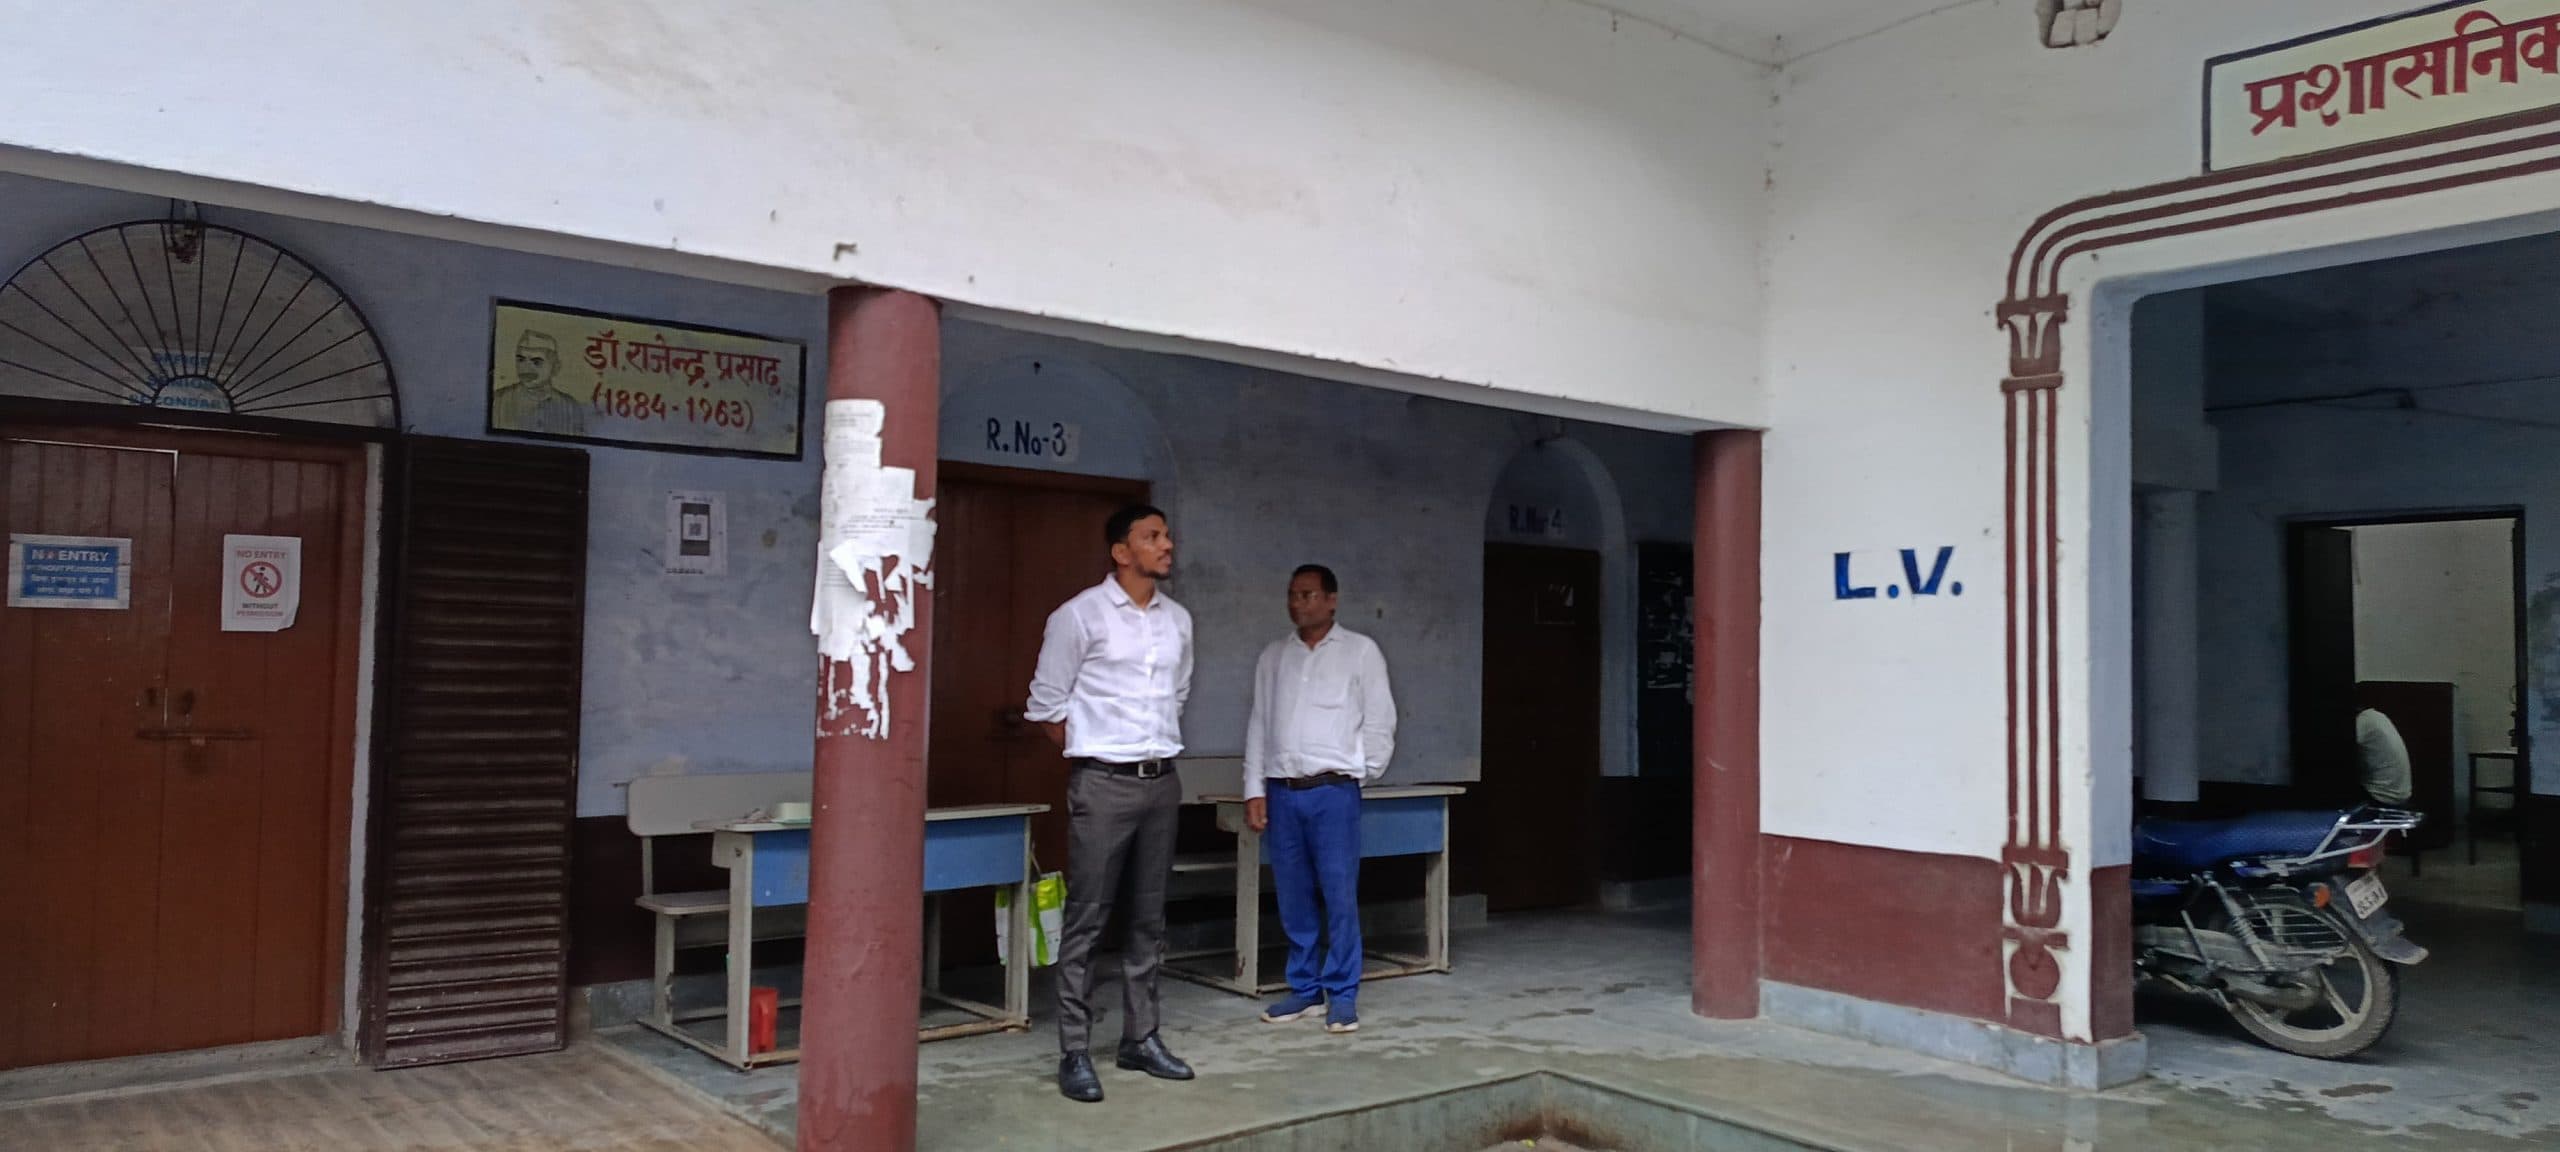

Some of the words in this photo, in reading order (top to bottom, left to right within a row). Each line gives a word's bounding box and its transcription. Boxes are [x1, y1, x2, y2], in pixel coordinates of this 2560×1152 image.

[58, 550, 109, 562] ENTRY
[236, 550, 252, 558] NO
[254, 551, 287, 559] ENTRY
[1834, 546, 1963, 600] L.V.
